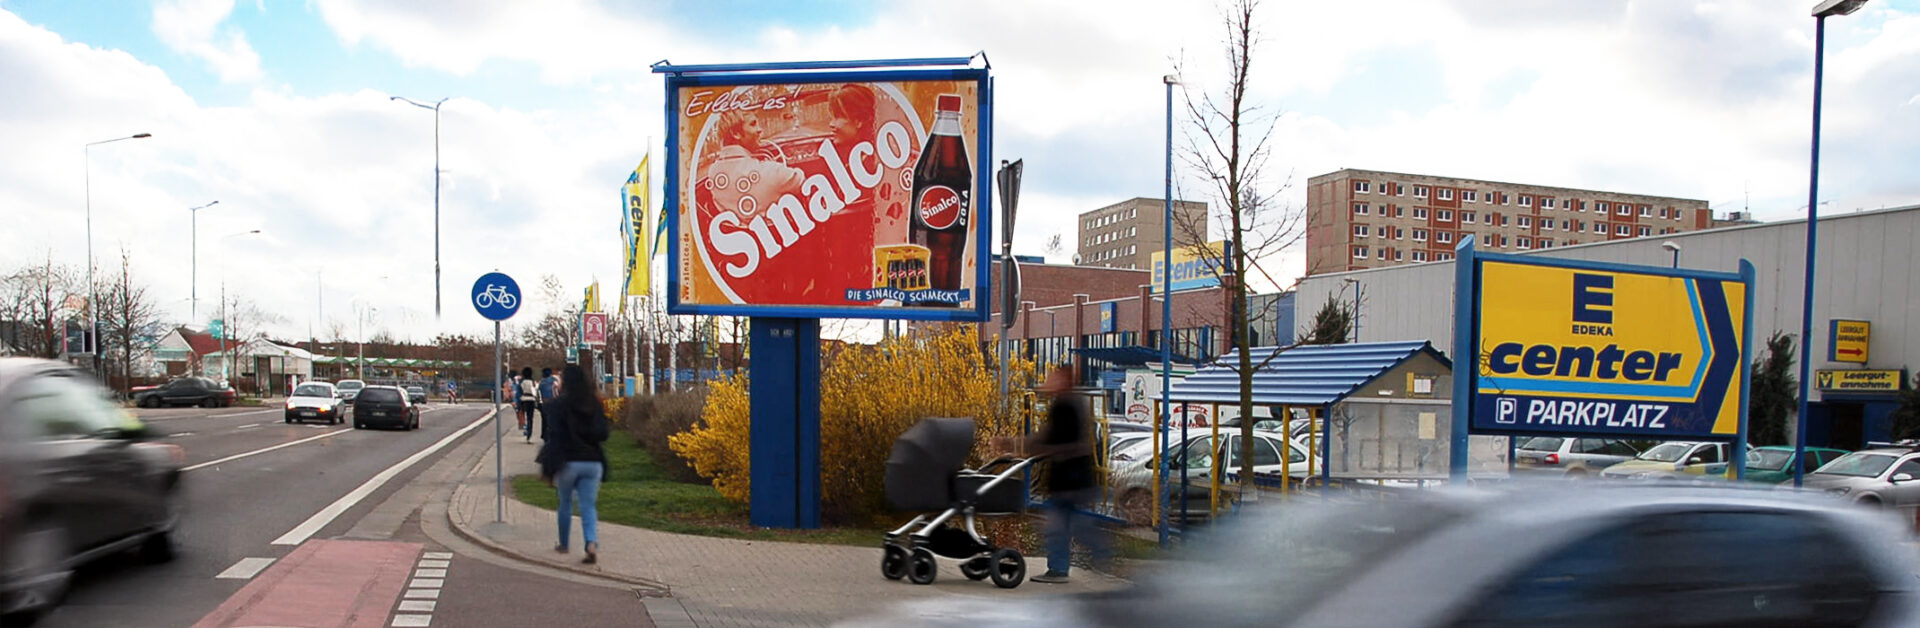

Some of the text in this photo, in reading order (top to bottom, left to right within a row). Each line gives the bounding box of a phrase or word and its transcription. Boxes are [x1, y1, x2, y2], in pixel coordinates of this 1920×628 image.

[686, 91, 762, 116] Erlebe
[709, 121, 911, 278] Sinalco
[922, 195, 957, 219] Sinalco
[960, 190, 968, 226] COLA
[1171, 255, 1223, 280] enter
[847, 289, 861, 300] DIE
[866, 288, 905, 301] SINALCO
[1572, 273, 1614, 324] E
[1572, 325, 1613, 337] EDEKA
[1490, 342, 1683, 382] center
[1840, 380, 1892, 388] annahme
[1526, 400, 1669, 429] PARKPLATZ
